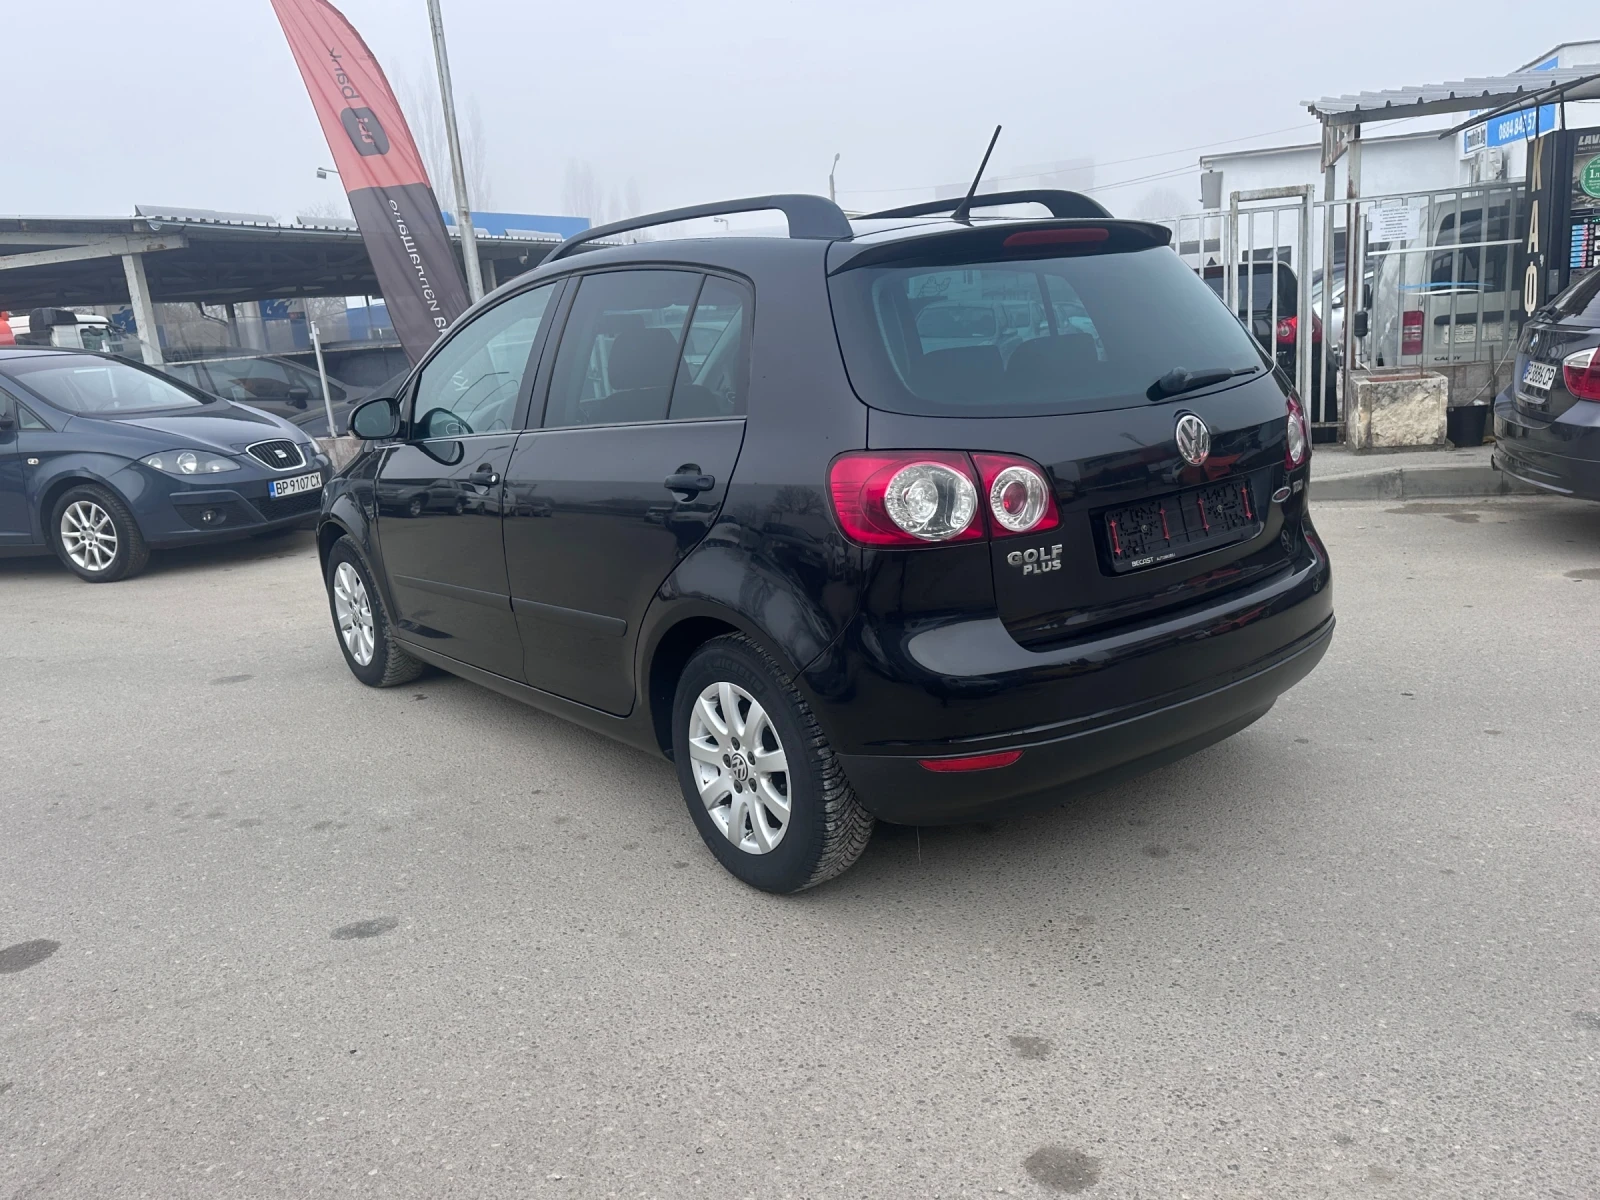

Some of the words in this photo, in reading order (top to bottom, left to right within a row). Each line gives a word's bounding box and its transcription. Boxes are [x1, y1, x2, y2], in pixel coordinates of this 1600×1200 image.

[1578, 134, 1600, 146] LAV
[1524, 136, 1544, 317] КАФ
[275, 481, 289, 495] BP
[289, 476, 309, 492] 9107
[310, 473, 321, 488] CX
[1007, 544, 1063, 566] GOLF
[1022, 559, 1062, 575] PLUS
